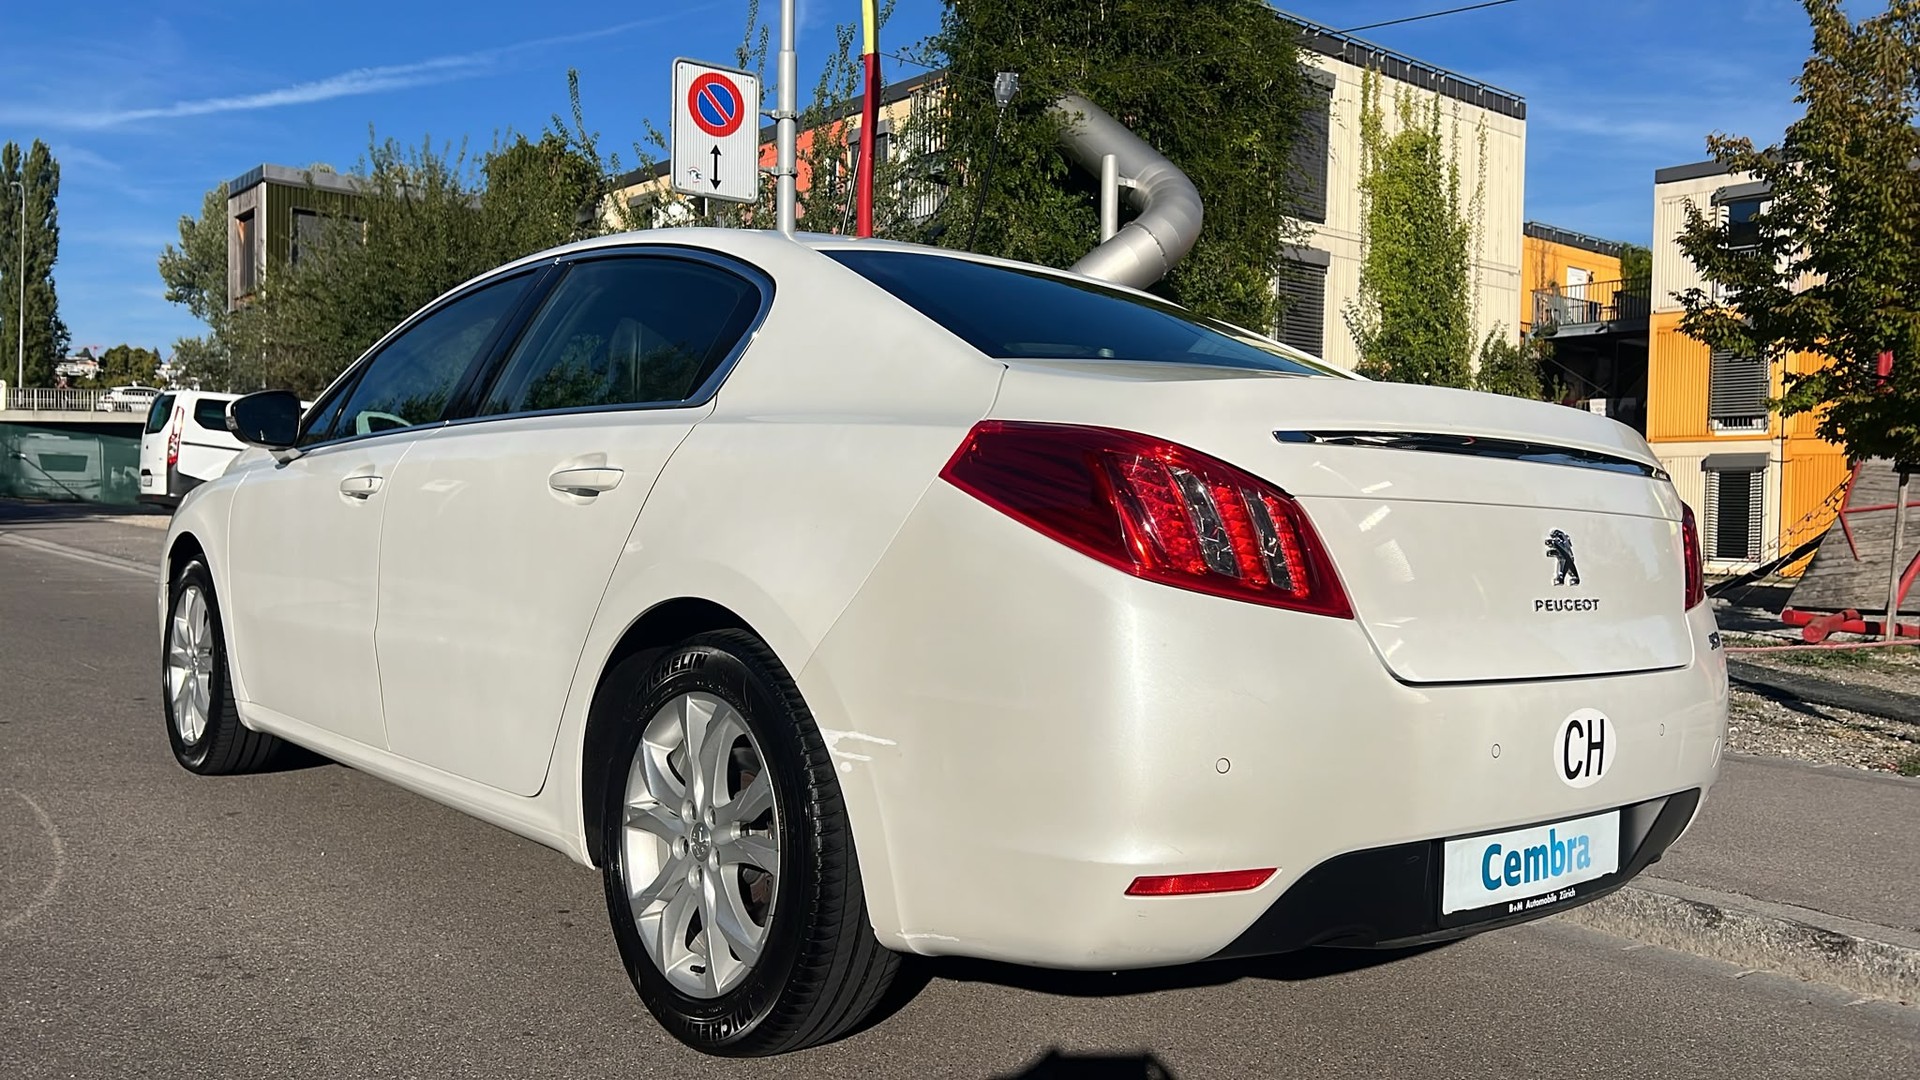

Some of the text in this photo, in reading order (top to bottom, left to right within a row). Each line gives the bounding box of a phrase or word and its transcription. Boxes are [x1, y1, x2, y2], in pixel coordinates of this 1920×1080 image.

[1533, 598, 1600, 612] PEUGEOT
[1563, 718, 1605, 780] CH
[1481, 828, 1591, 891] Cembra
[1508, 887, 1576, 913] B+M Automobile Zürich
